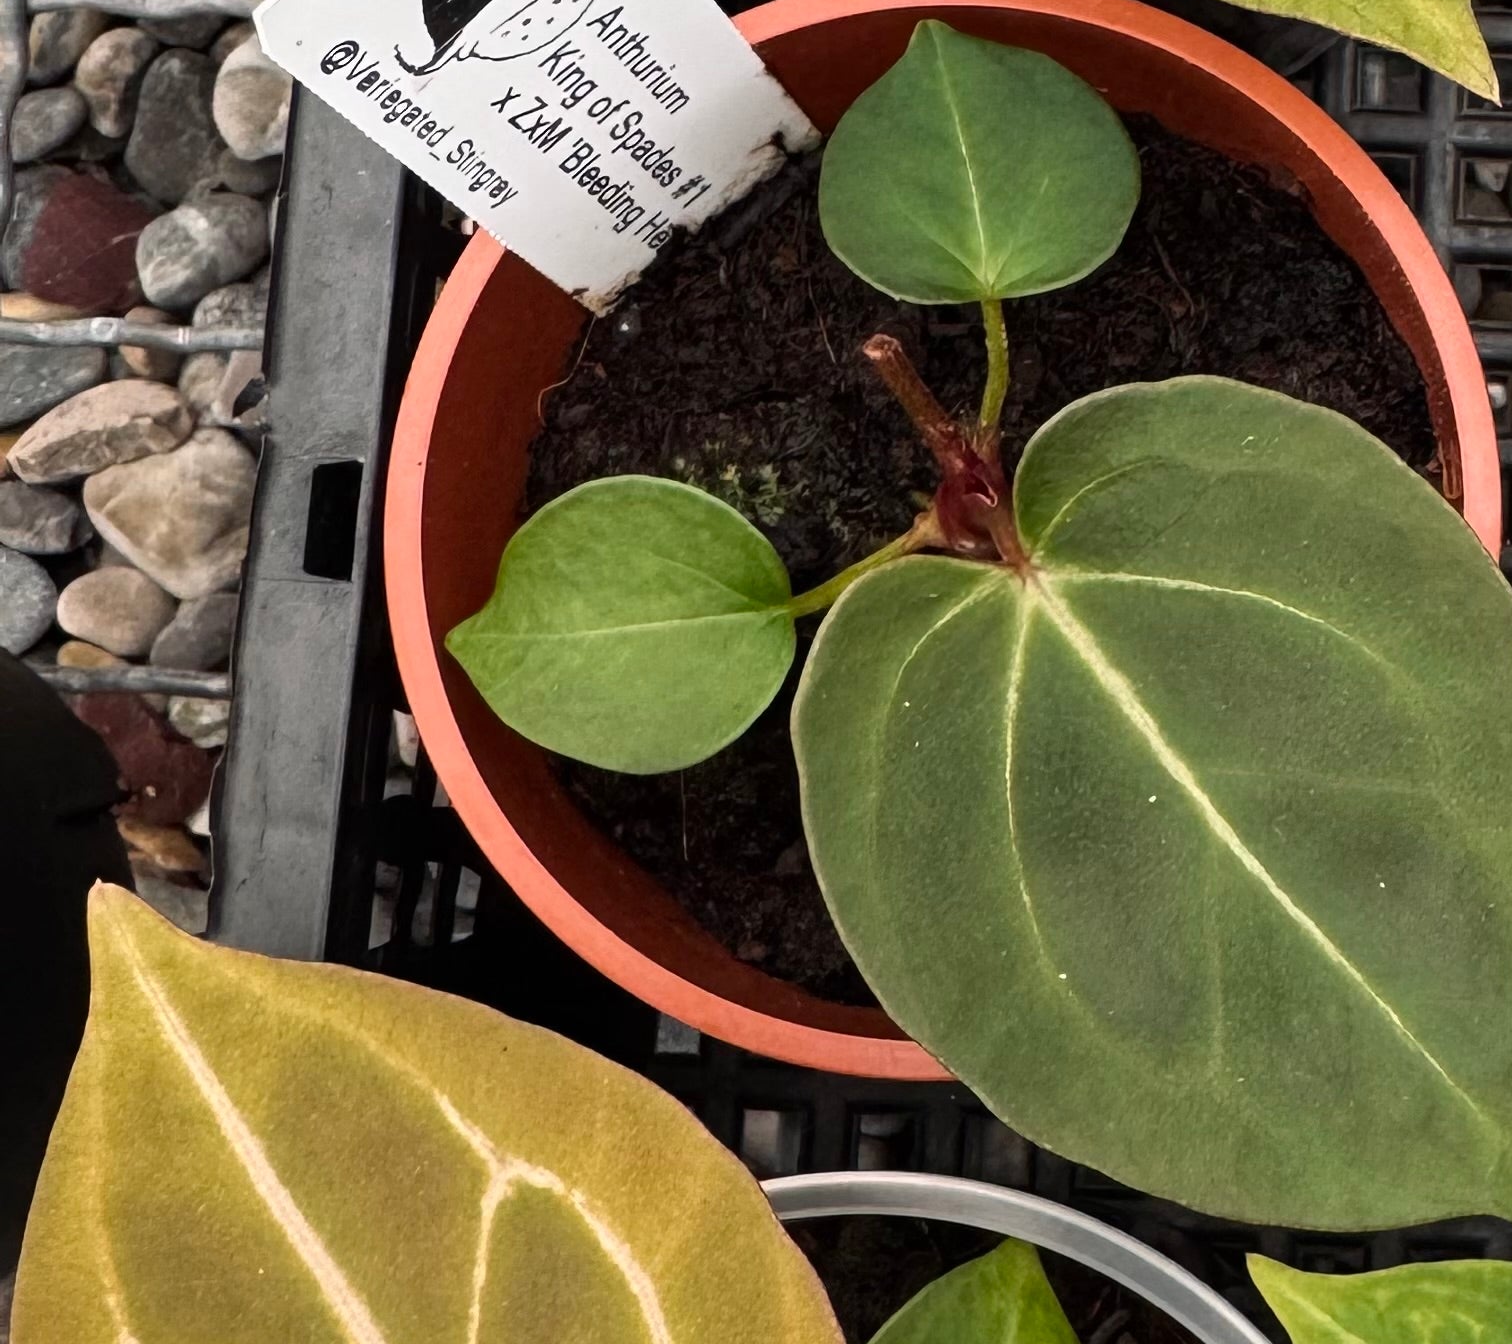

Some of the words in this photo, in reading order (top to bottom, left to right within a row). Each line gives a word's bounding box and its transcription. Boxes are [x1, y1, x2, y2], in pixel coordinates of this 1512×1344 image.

[320, 40, 519, 210] @Variegated_Stingray
[539, 41, 597, 108] King
[588, 99, 625, 126] of
[611, 112, 683, 188] Spades
[671, 175, 712, 209] #1
[586, 6, 690, 115] Anthurium
[490, 86, 520, 113] x
[508, 96, 572, 154] ZxM
[633, 210, 671, 249] He
